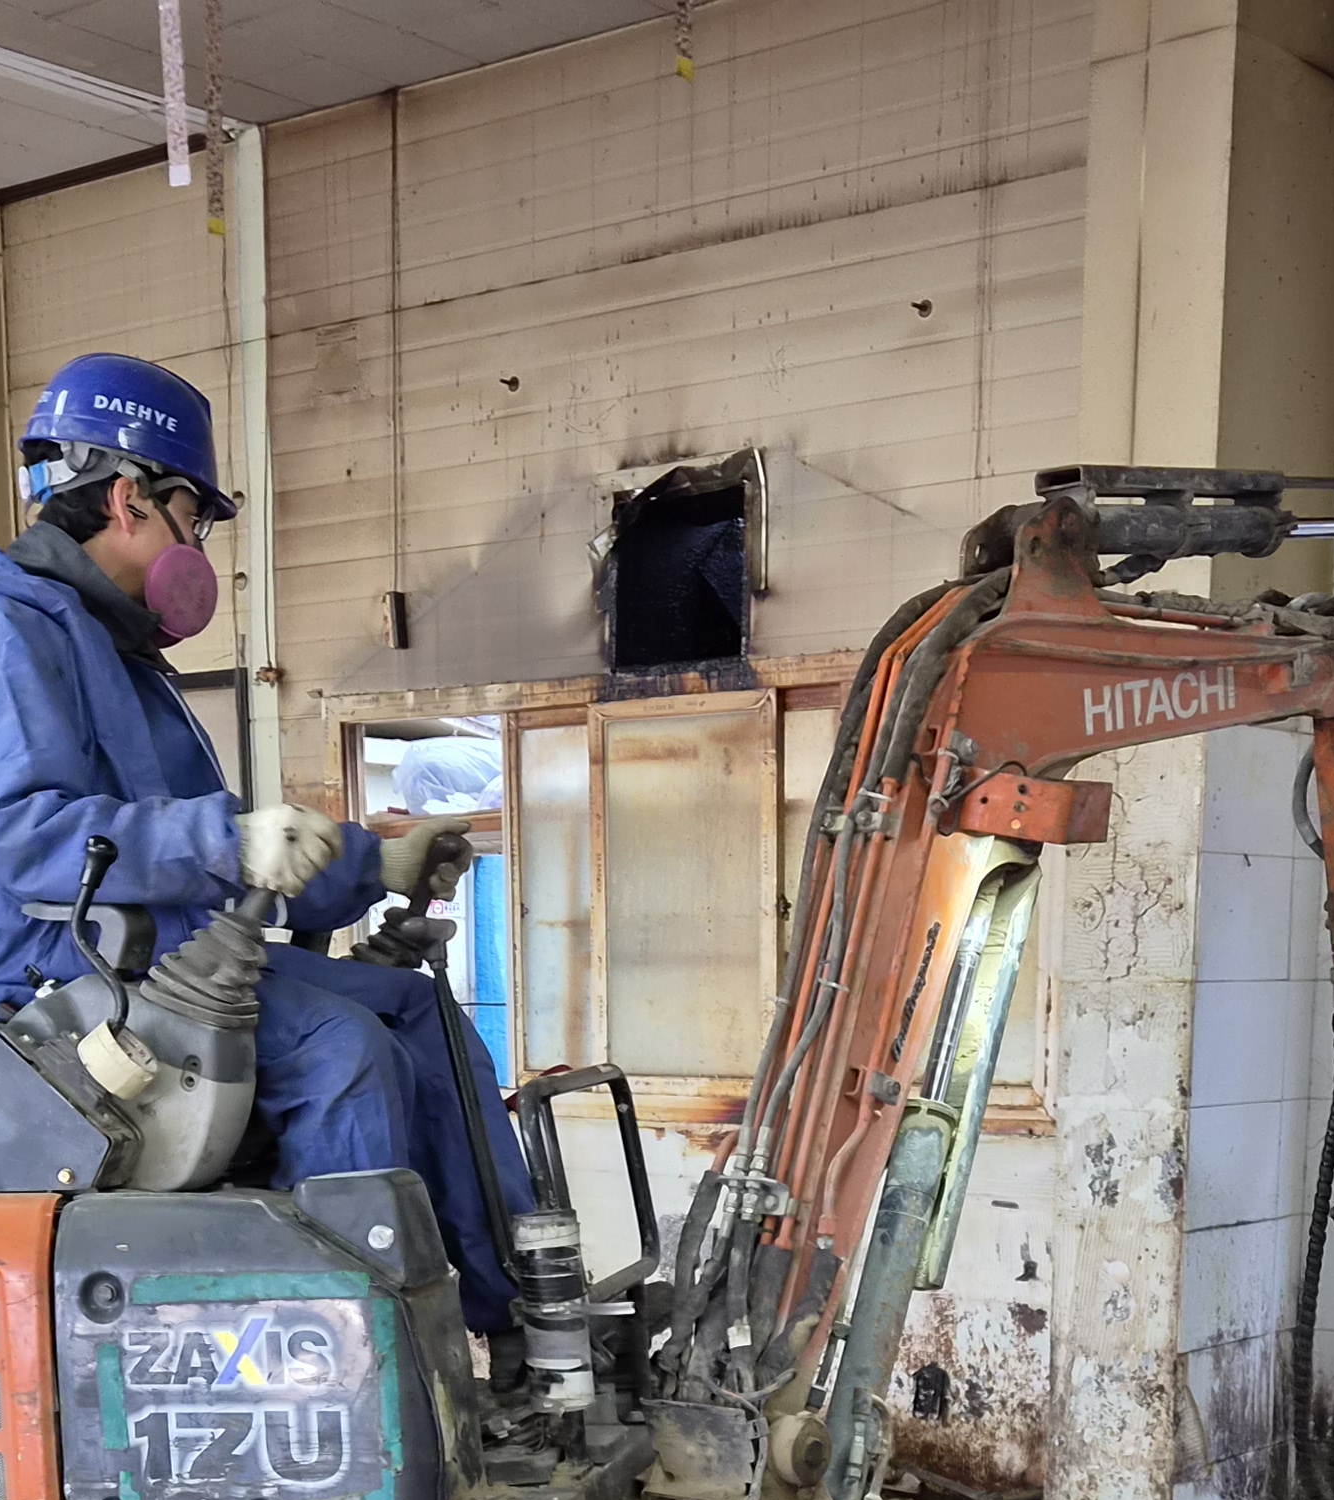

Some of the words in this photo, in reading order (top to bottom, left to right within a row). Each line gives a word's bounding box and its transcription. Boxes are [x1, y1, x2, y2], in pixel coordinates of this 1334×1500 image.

[94, 395, 178, 432] DAEHYE
[1083, 665, 1236, 736] HITACHI
[125, 1316, 333, 1389] ZAXIS
[131, 1406, 347, 1486] 17U
